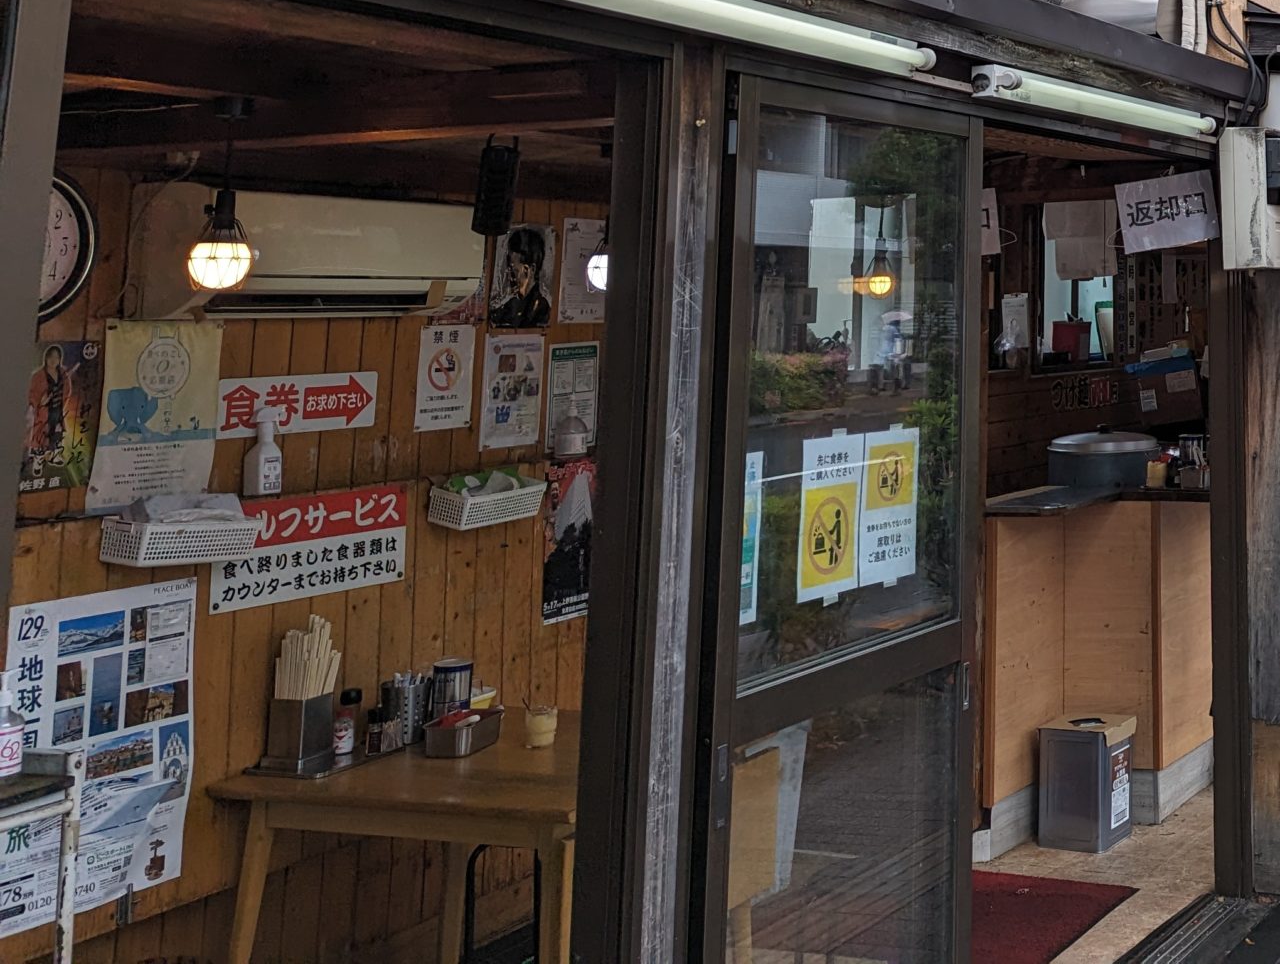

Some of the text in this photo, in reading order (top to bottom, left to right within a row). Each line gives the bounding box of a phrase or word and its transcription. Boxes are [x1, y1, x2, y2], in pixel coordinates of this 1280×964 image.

[433, 330, 460, 344] 禁煙
[306, 393, 368, 412] お求め下さい
[816, 452, 850, 465] 先に食券を
[258, 493, 400, 541] ルフサービス
[222, 536, 398, 580] 食べ終りました食器類は
[153, 585, 176, 595] PEACE
[221, 558, 397, 603] カウンターまでお持ち下さい
[17, 615, 45, 642] 129
